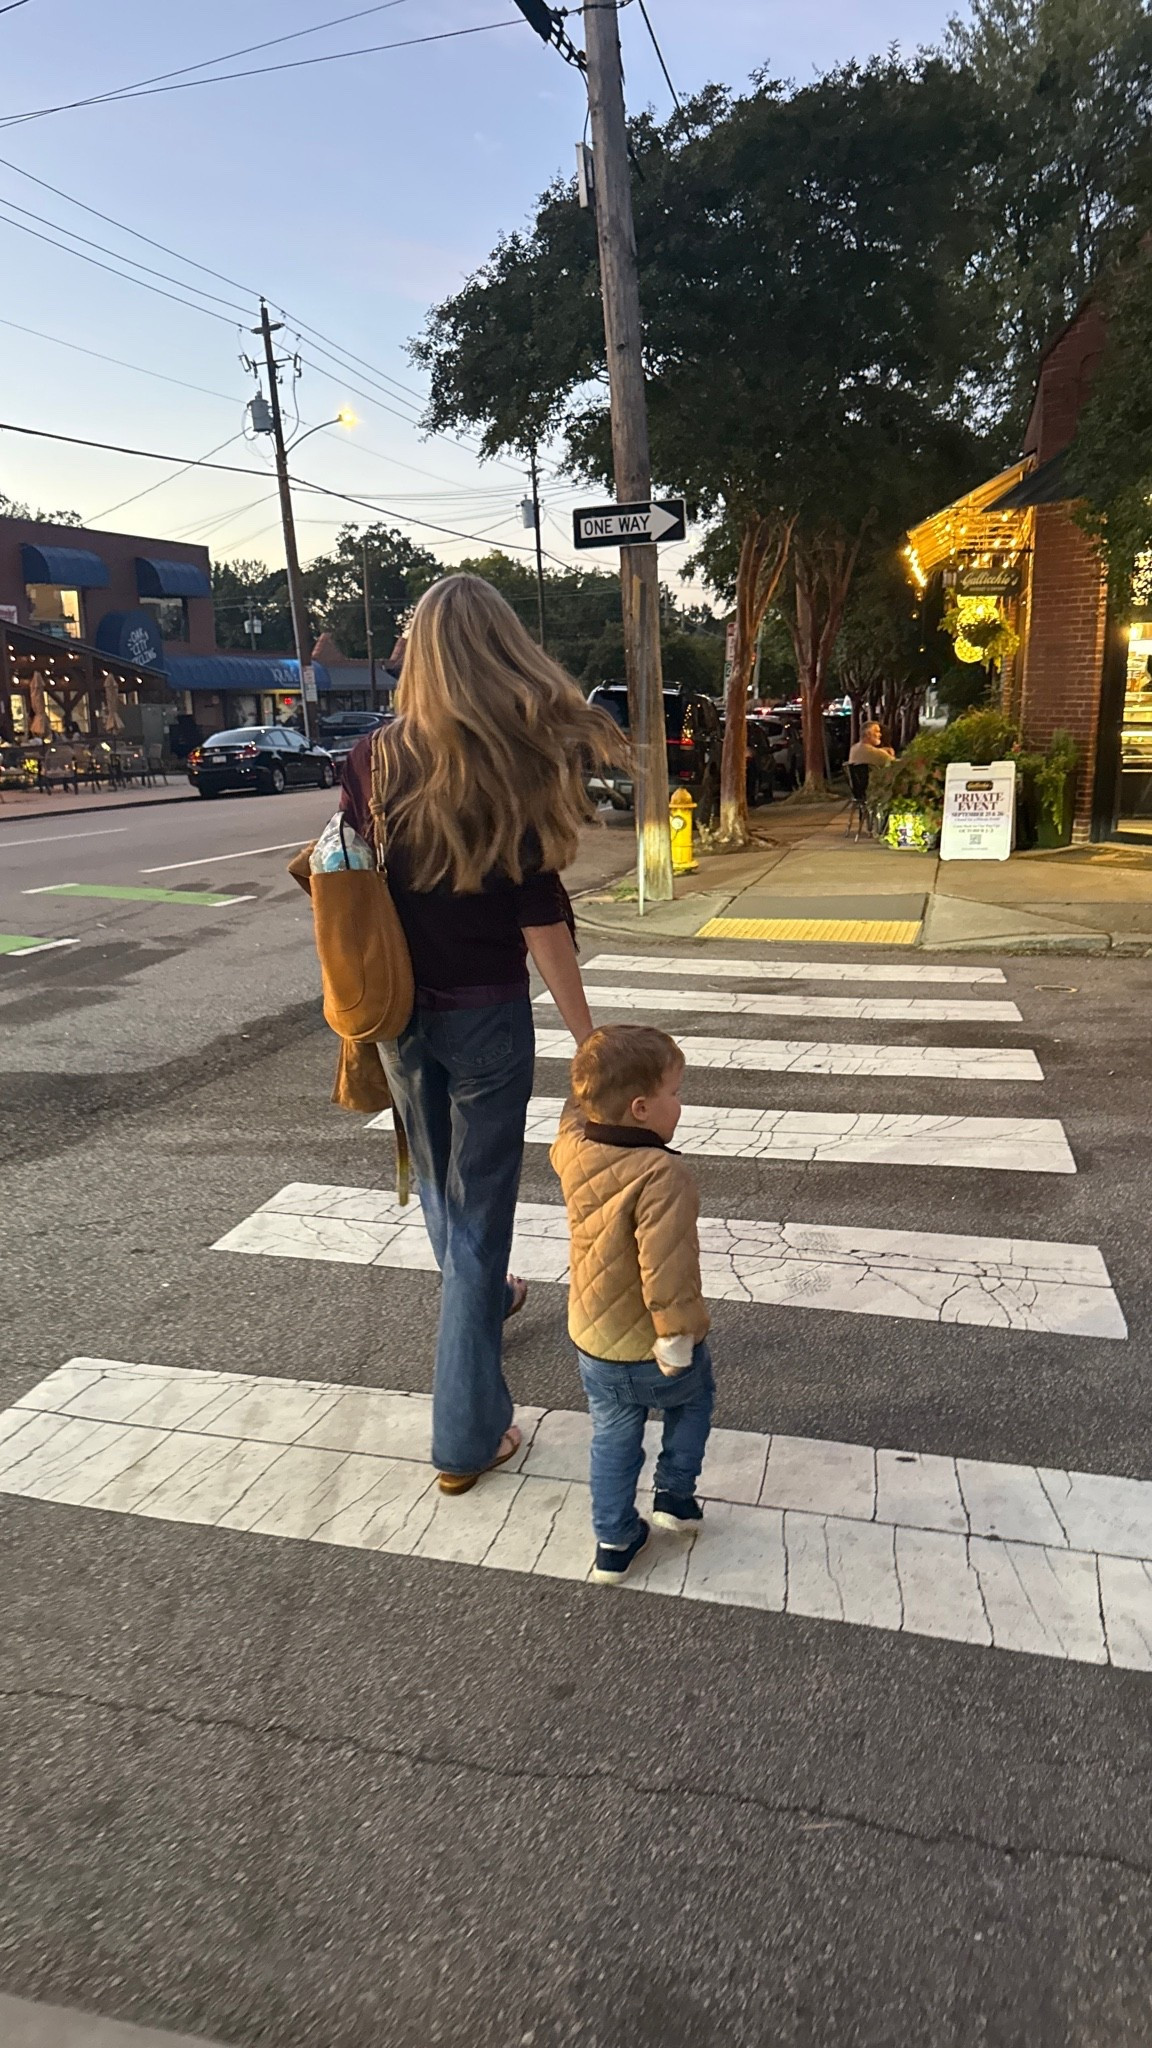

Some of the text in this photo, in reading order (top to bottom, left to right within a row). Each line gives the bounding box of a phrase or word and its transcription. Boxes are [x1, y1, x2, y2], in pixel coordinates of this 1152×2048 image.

[584, 515, 650, 536] ONE WAY
[132, 639, 147, 655] CITY
[954, 792, 1004, 802] PRIVATE
[958, 801, 998, 811] EVENT
